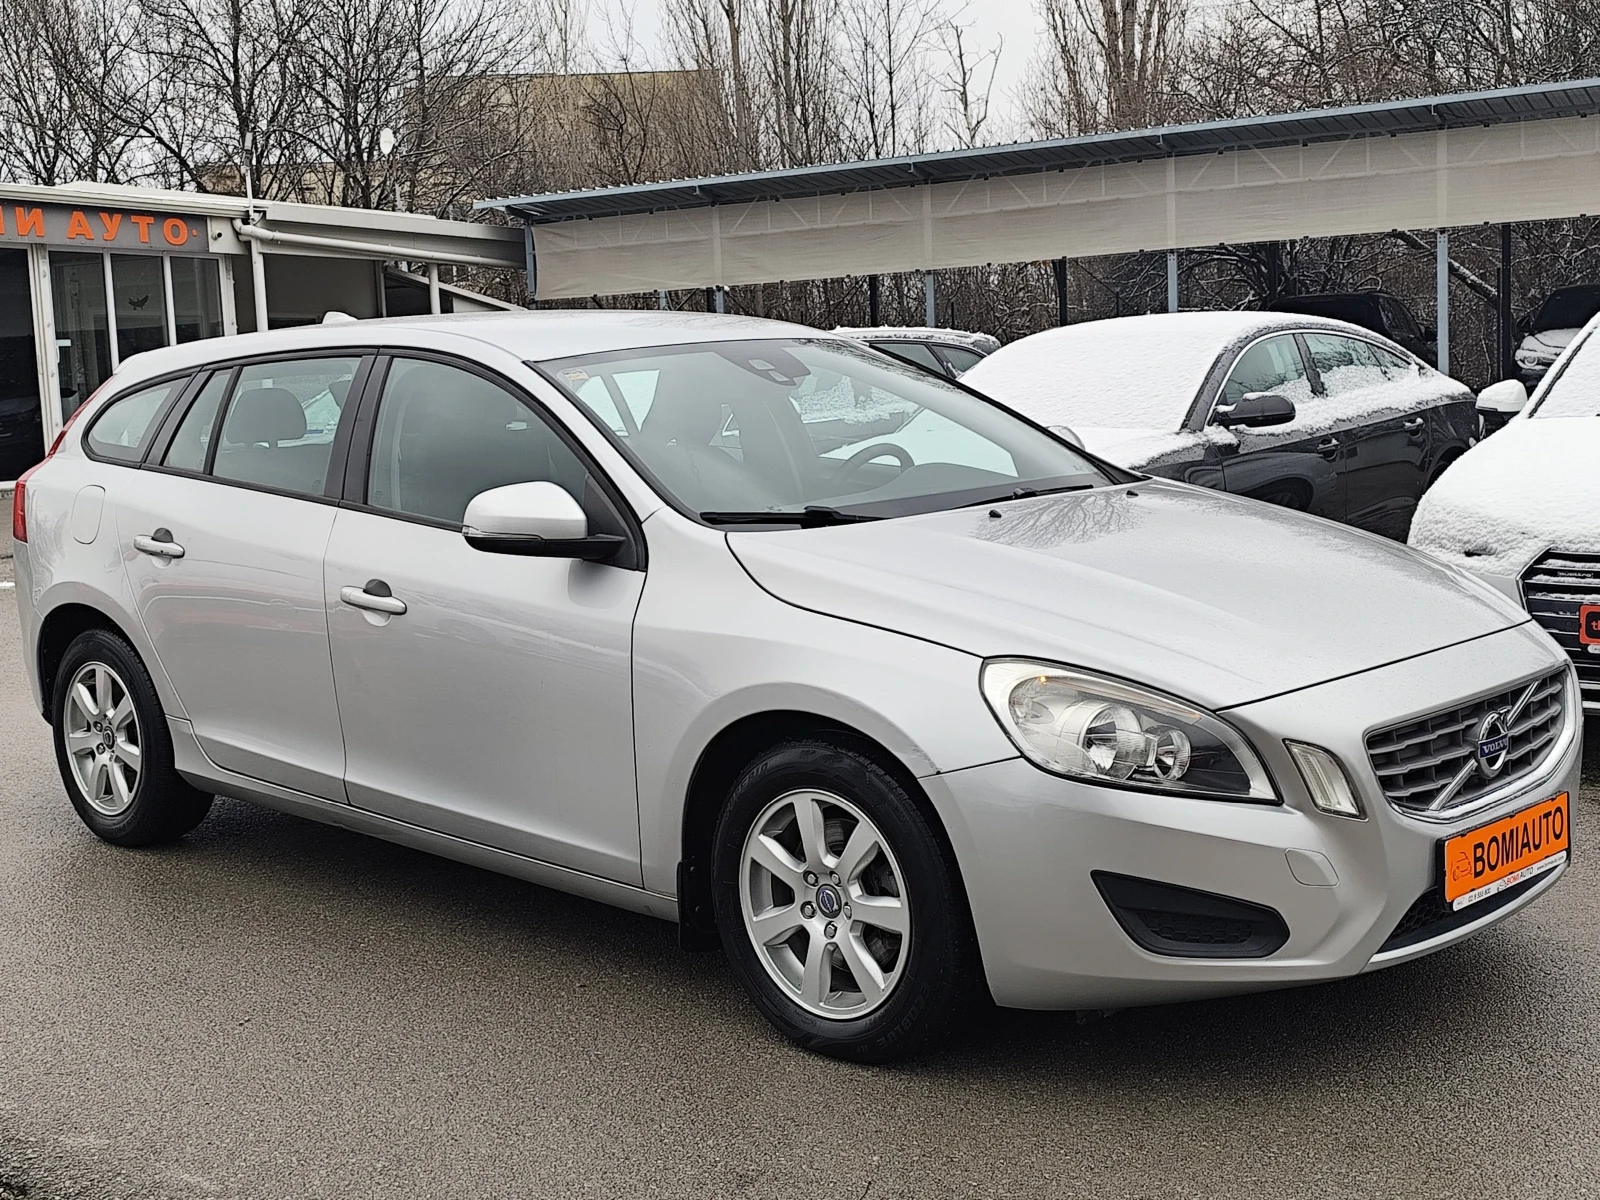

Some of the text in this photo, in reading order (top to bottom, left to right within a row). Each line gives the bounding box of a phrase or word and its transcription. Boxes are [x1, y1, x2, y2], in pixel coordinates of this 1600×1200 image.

[0, 205, 189, 246] И АУТО
[1483, 737, 1508, 754] VOLVO
[1473, 805, 1564, 880] BOMIAUTO
